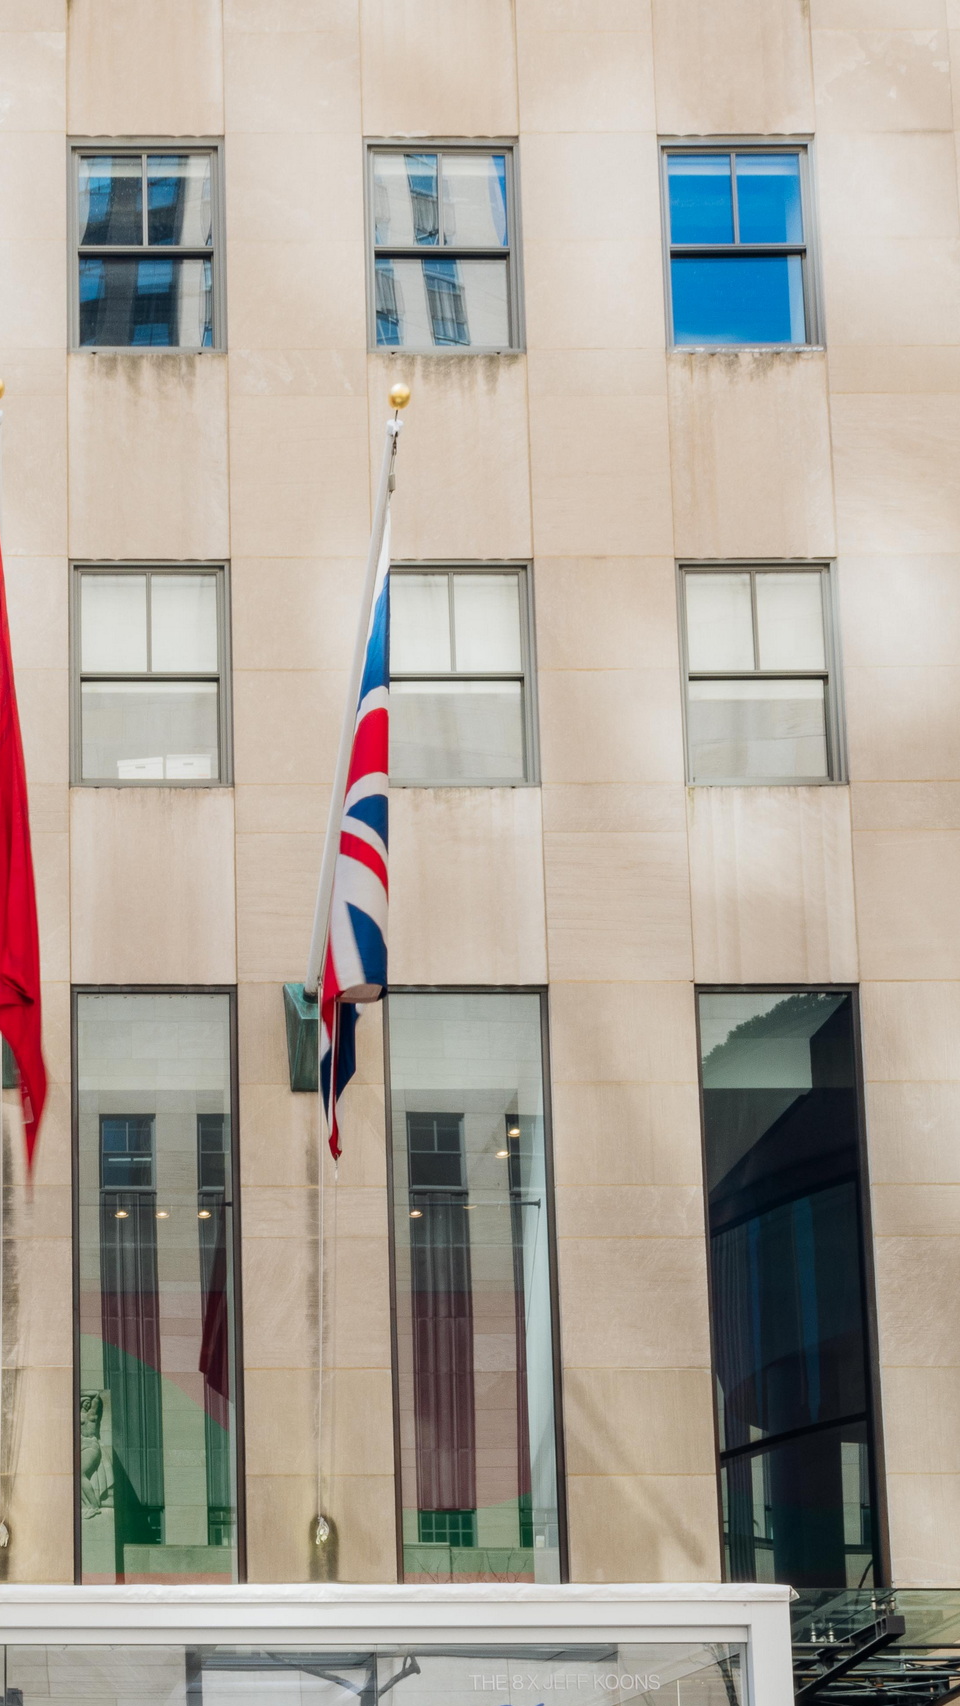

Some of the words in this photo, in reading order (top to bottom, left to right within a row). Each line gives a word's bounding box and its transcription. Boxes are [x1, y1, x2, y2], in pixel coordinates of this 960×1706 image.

[469, 1674, 508, 1691] THE
[512, 1674, 524, 1691] 8
[527, 1674, 540, 1691] X
[542, 1674, 589, 1691] JEFF
[593, 1674, 661, 1691] KOONS
